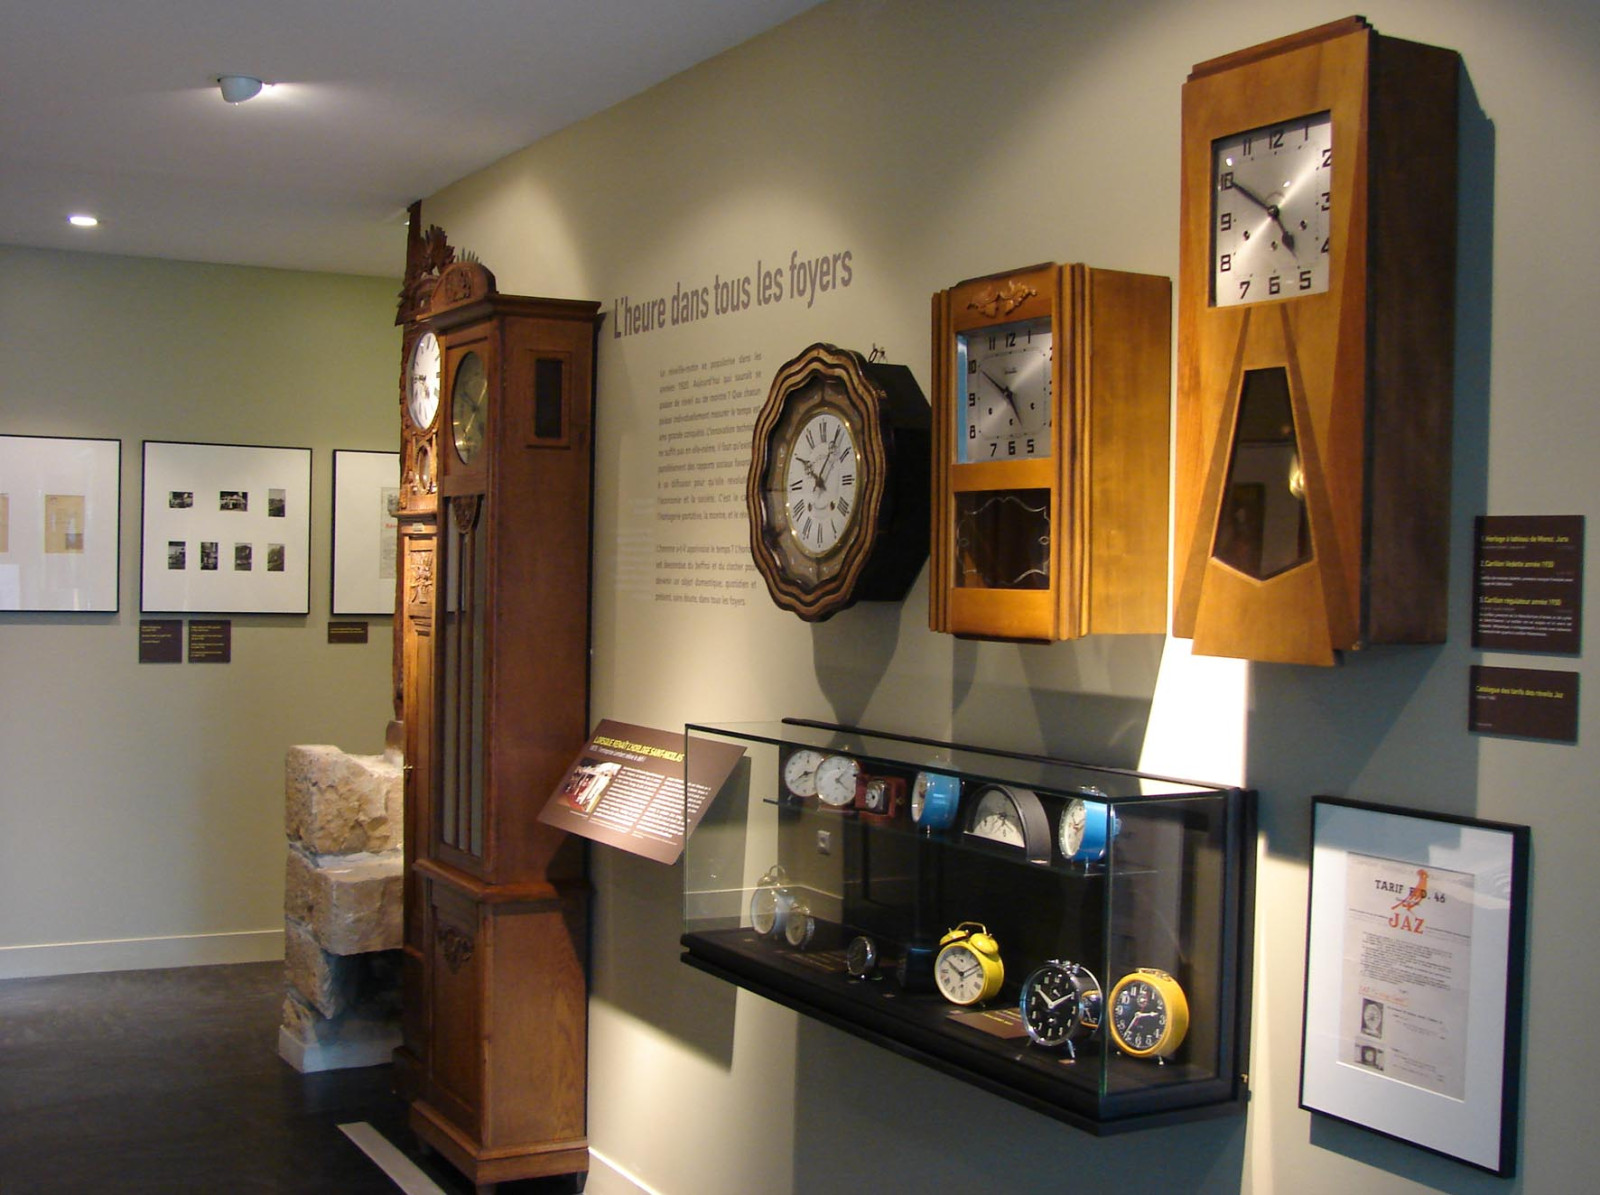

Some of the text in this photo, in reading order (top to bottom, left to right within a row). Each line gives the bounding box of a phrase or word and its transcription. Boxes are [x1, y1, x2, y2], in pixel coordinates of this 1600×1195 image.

[1242, 138, 1252, 156] 11
[1268, 130, 1284, 150] 12
[1220, 212, 1232, 232] 9
[1220, 254, 1231, 272] 8
[1239, 280, 1251, 300] 7
[1268, 276, 1280, 295] 6
[1299, 270, 1312, 291] 5
[614, 250, 853, 339] L'heure dans tous les foyers
[1374, 879, 1404, 894] TARIF
[1434, 891, 1446, 904] 46
[1388, 912, 1425, 935] JAZ
